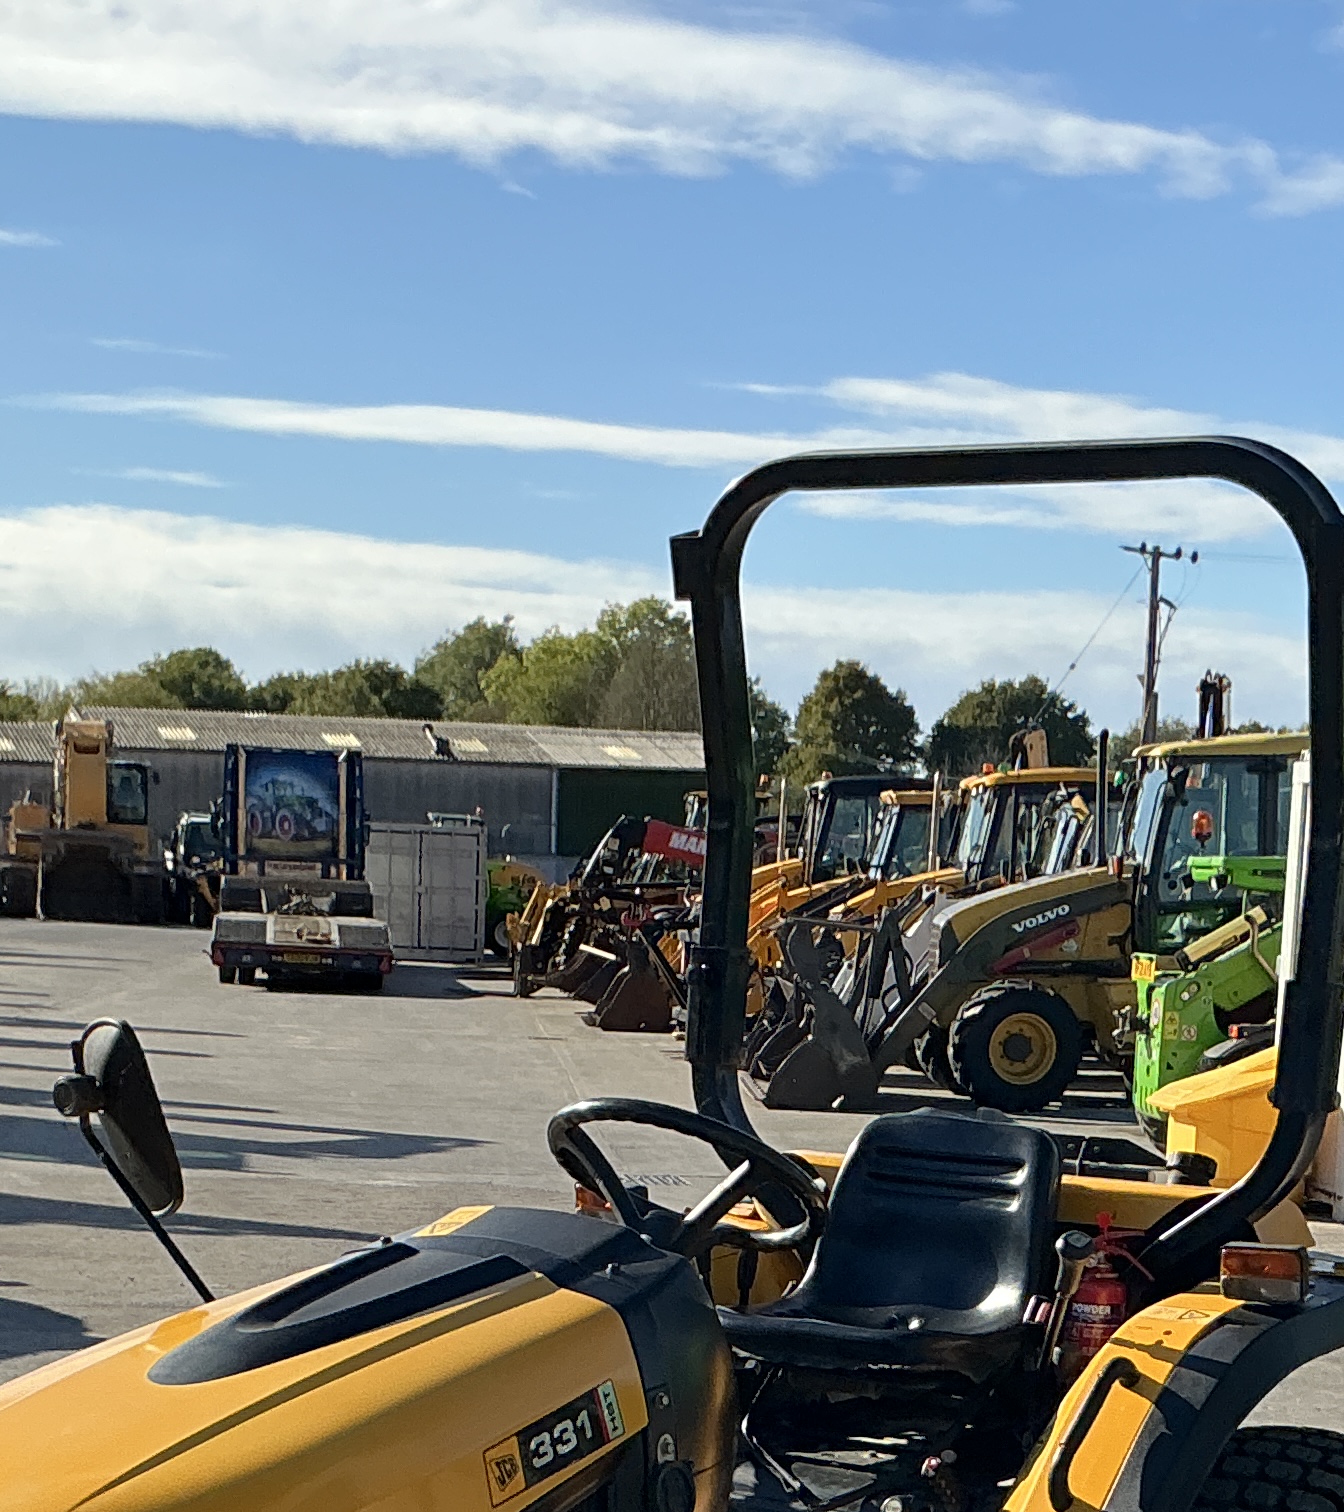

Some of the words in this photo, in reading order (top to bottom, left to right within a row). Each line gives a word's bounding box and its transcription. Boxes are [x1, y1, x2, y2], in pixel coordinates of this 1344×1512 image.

[1012, 904, 1070, 932] VOLVO
[1072, 1303, 1111, 1315] POWDER
[494, 1457, 519, 1486] JCB
[529, 1409, 593, 1469] 331
